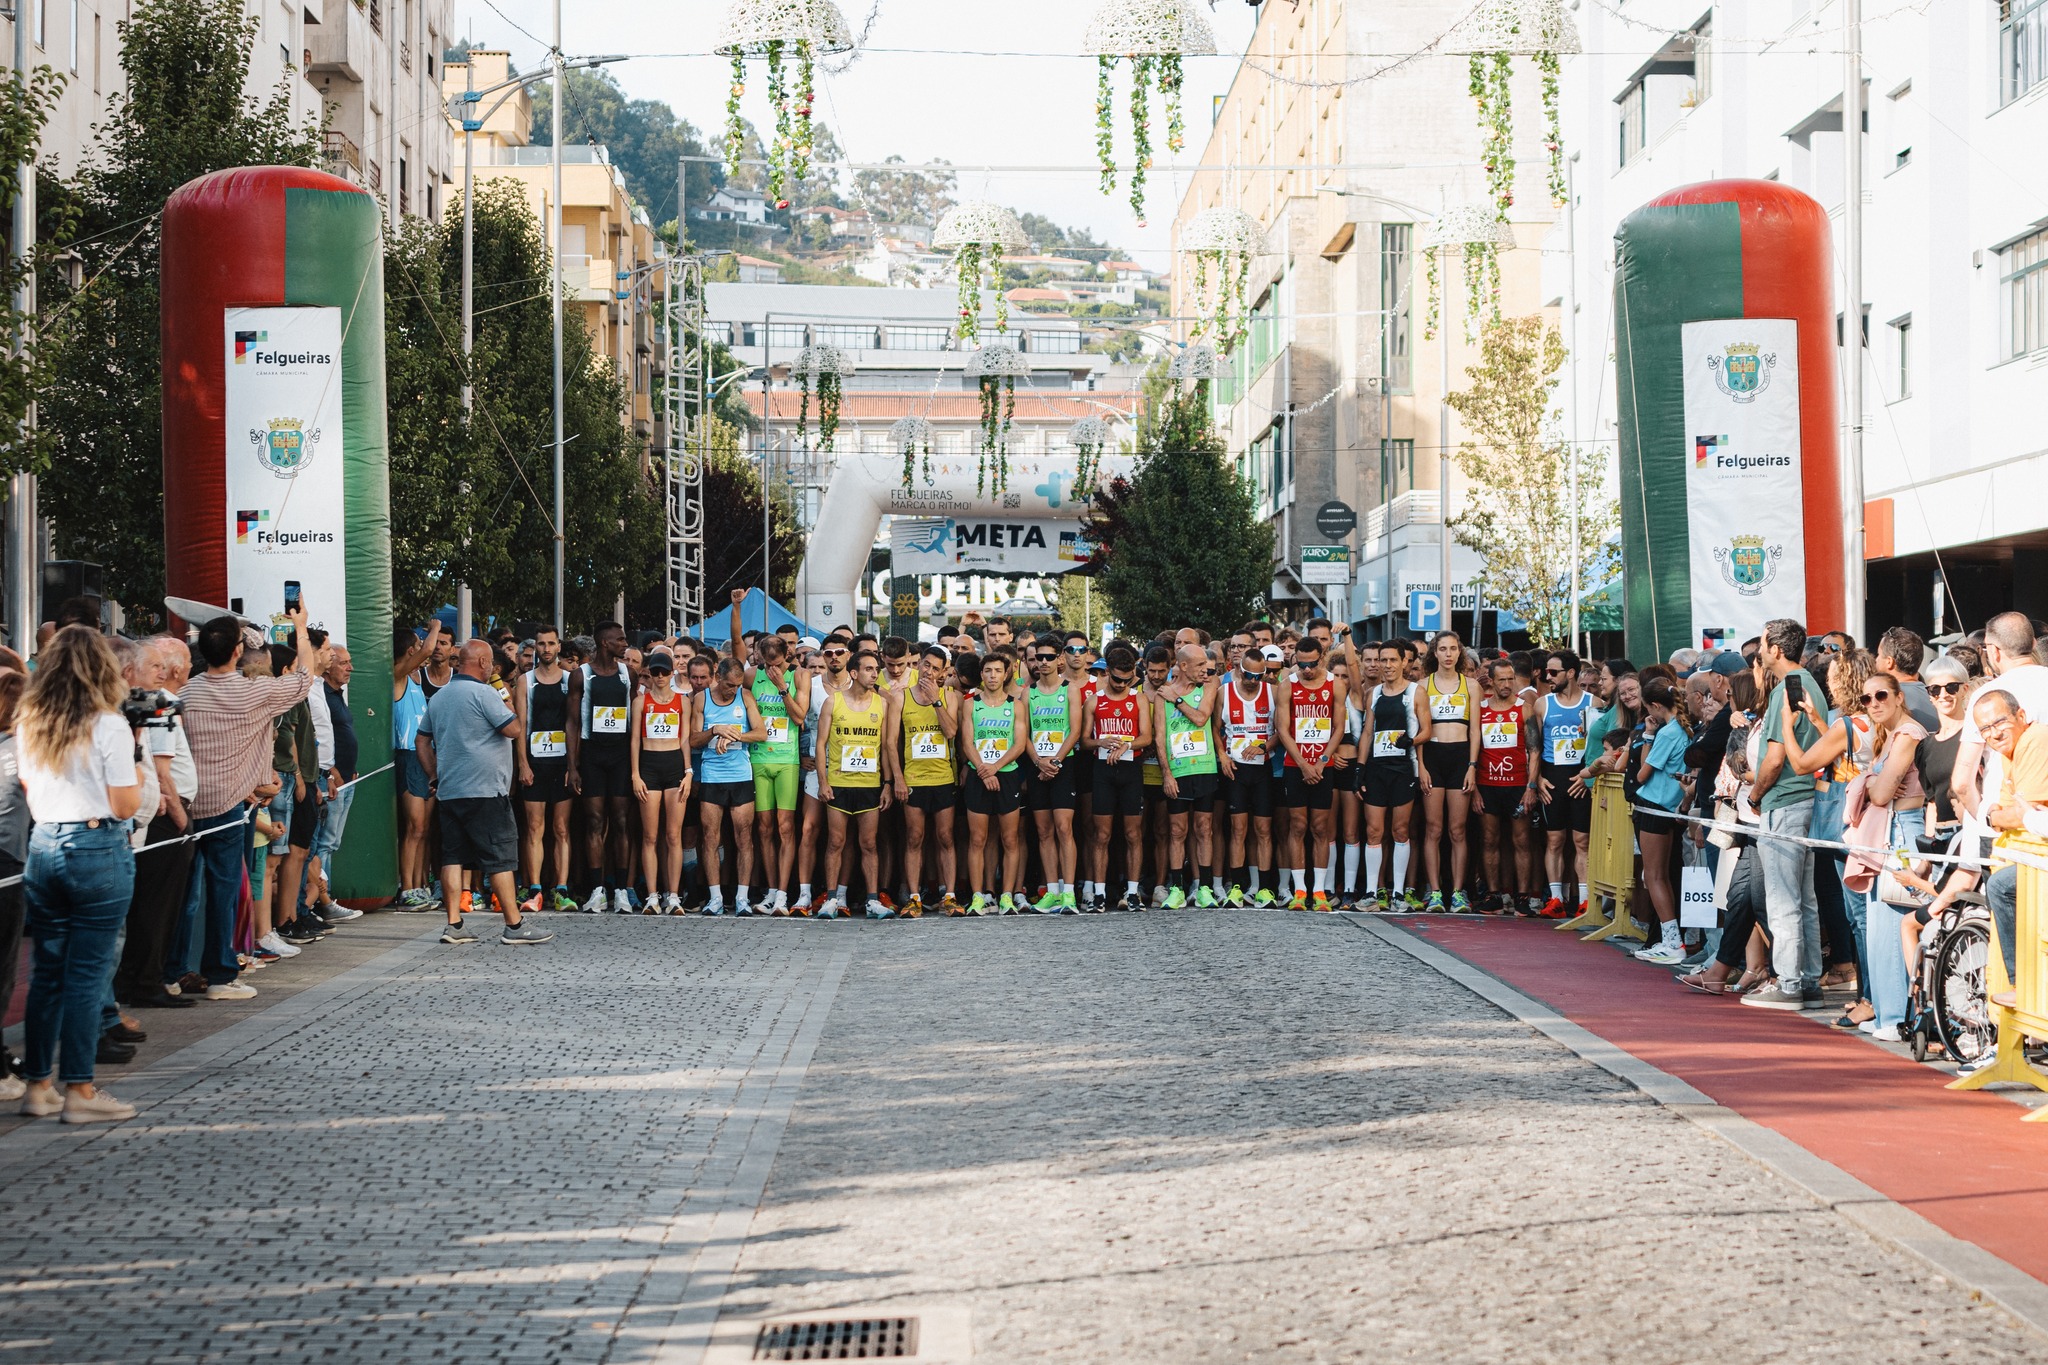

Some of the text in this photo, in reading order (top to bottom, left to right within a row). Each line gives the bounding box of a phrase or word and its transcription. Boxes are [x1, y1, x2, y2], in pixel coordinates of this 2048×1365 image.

[256, 351, 331, 366] Felgueiras
[1717, 454, 1790, 470] Felgueiras
[891, 501, 972, 511] MARCA O RITMO!
[258, 530, 333, 546] Felgueiras
[956, 523, 1047, 548] META
[1303, 548, 1329, 557] EURO
[1406, 584, 1463, 592] RESTAUNTE
[1418, 594, 1441, 627] P
[1033, 706, 1063, 715] jmm
[1439, 706, 1456, 714] 287
[604, 719, 616, 727] 85
[978, 717, 1010, 727] jmm
[654, 725, 672, 733] 232
[920, 723, 942, 732] VÁRZE
[1304, 730, 1321, 738] 237
[1491, 734, 1508, 743] 233
[920, 745, 938, 753] 285
[1038, 743, 1055, 751] 373
[1183, 743, 1195, 751] 63
[983, 750, 1001, 759] 376
[1565, 750, 1577, 758] 62
[850, 758, 868, 766] 274
[1489, 756, 1514, 776] MS
[1684, 892, 1714, 903] BOSS
